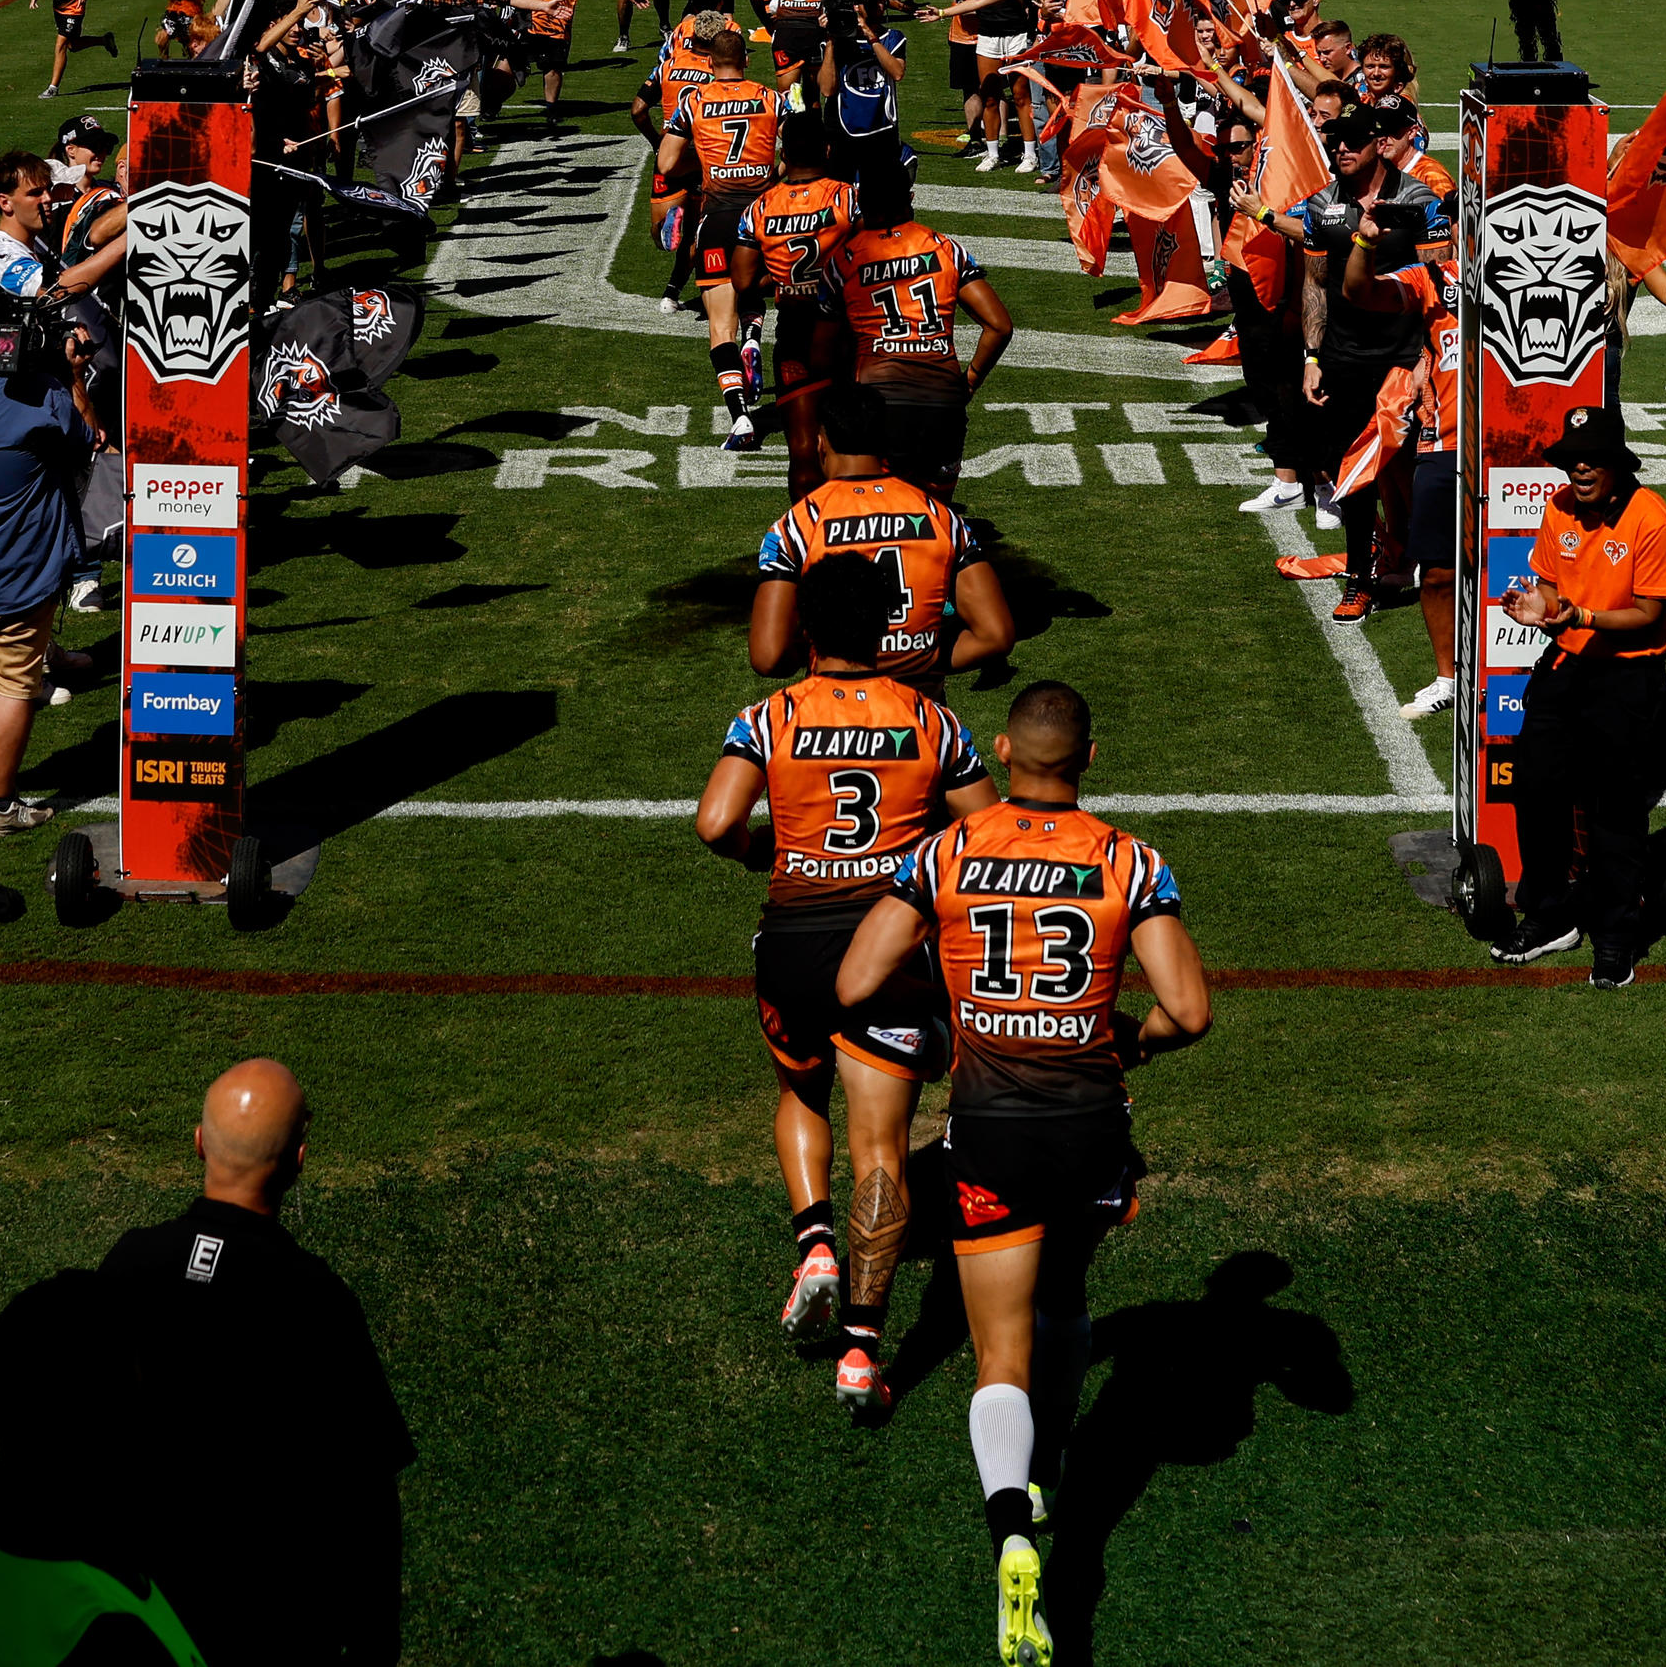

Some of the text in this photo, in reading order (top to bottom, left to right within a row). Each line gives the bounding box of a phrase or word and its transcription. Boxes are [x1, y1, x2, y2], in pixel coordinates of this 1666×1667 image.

[669, 68, 707, 81] PLAYUP
[704, 102, 749, 117] PLAYUP
[722, 119, 749, 164] 7
[710, 164, 770, 180] Formbay
[766, 214, 818, 234] PLAYUP
[787, 236, 822, 284] 2
[863, 258, 920, 283] PLAYUP
[870, 277, 945, 338] 11
[873, 335, 949, 355] Formbay
[147, 479, 223, 501] pepper
[158, 501, 212, 518] money
[827, 515, 906, 545] PLAYUP
[152, 573, 217, 588] ZURICH
[139, 625, 206, 645] PLAYUP
[142, 692, 221, 715] Formbay
[796, 728, 886, 757] PLAYUP
[136, 760, 226, 784] ISRI TRUCK
[190, 773, 225, 786] SEATS
[1491, 762, 1513, 784] IS
[823, 768, 882, 855] 3
[959, 860, 1066, 894] PLAYUP
[969, 902, 1096, 1004] 13
[959, 999, 1097, 1044] Formbay
[192, 1237, 220, 1274] E
